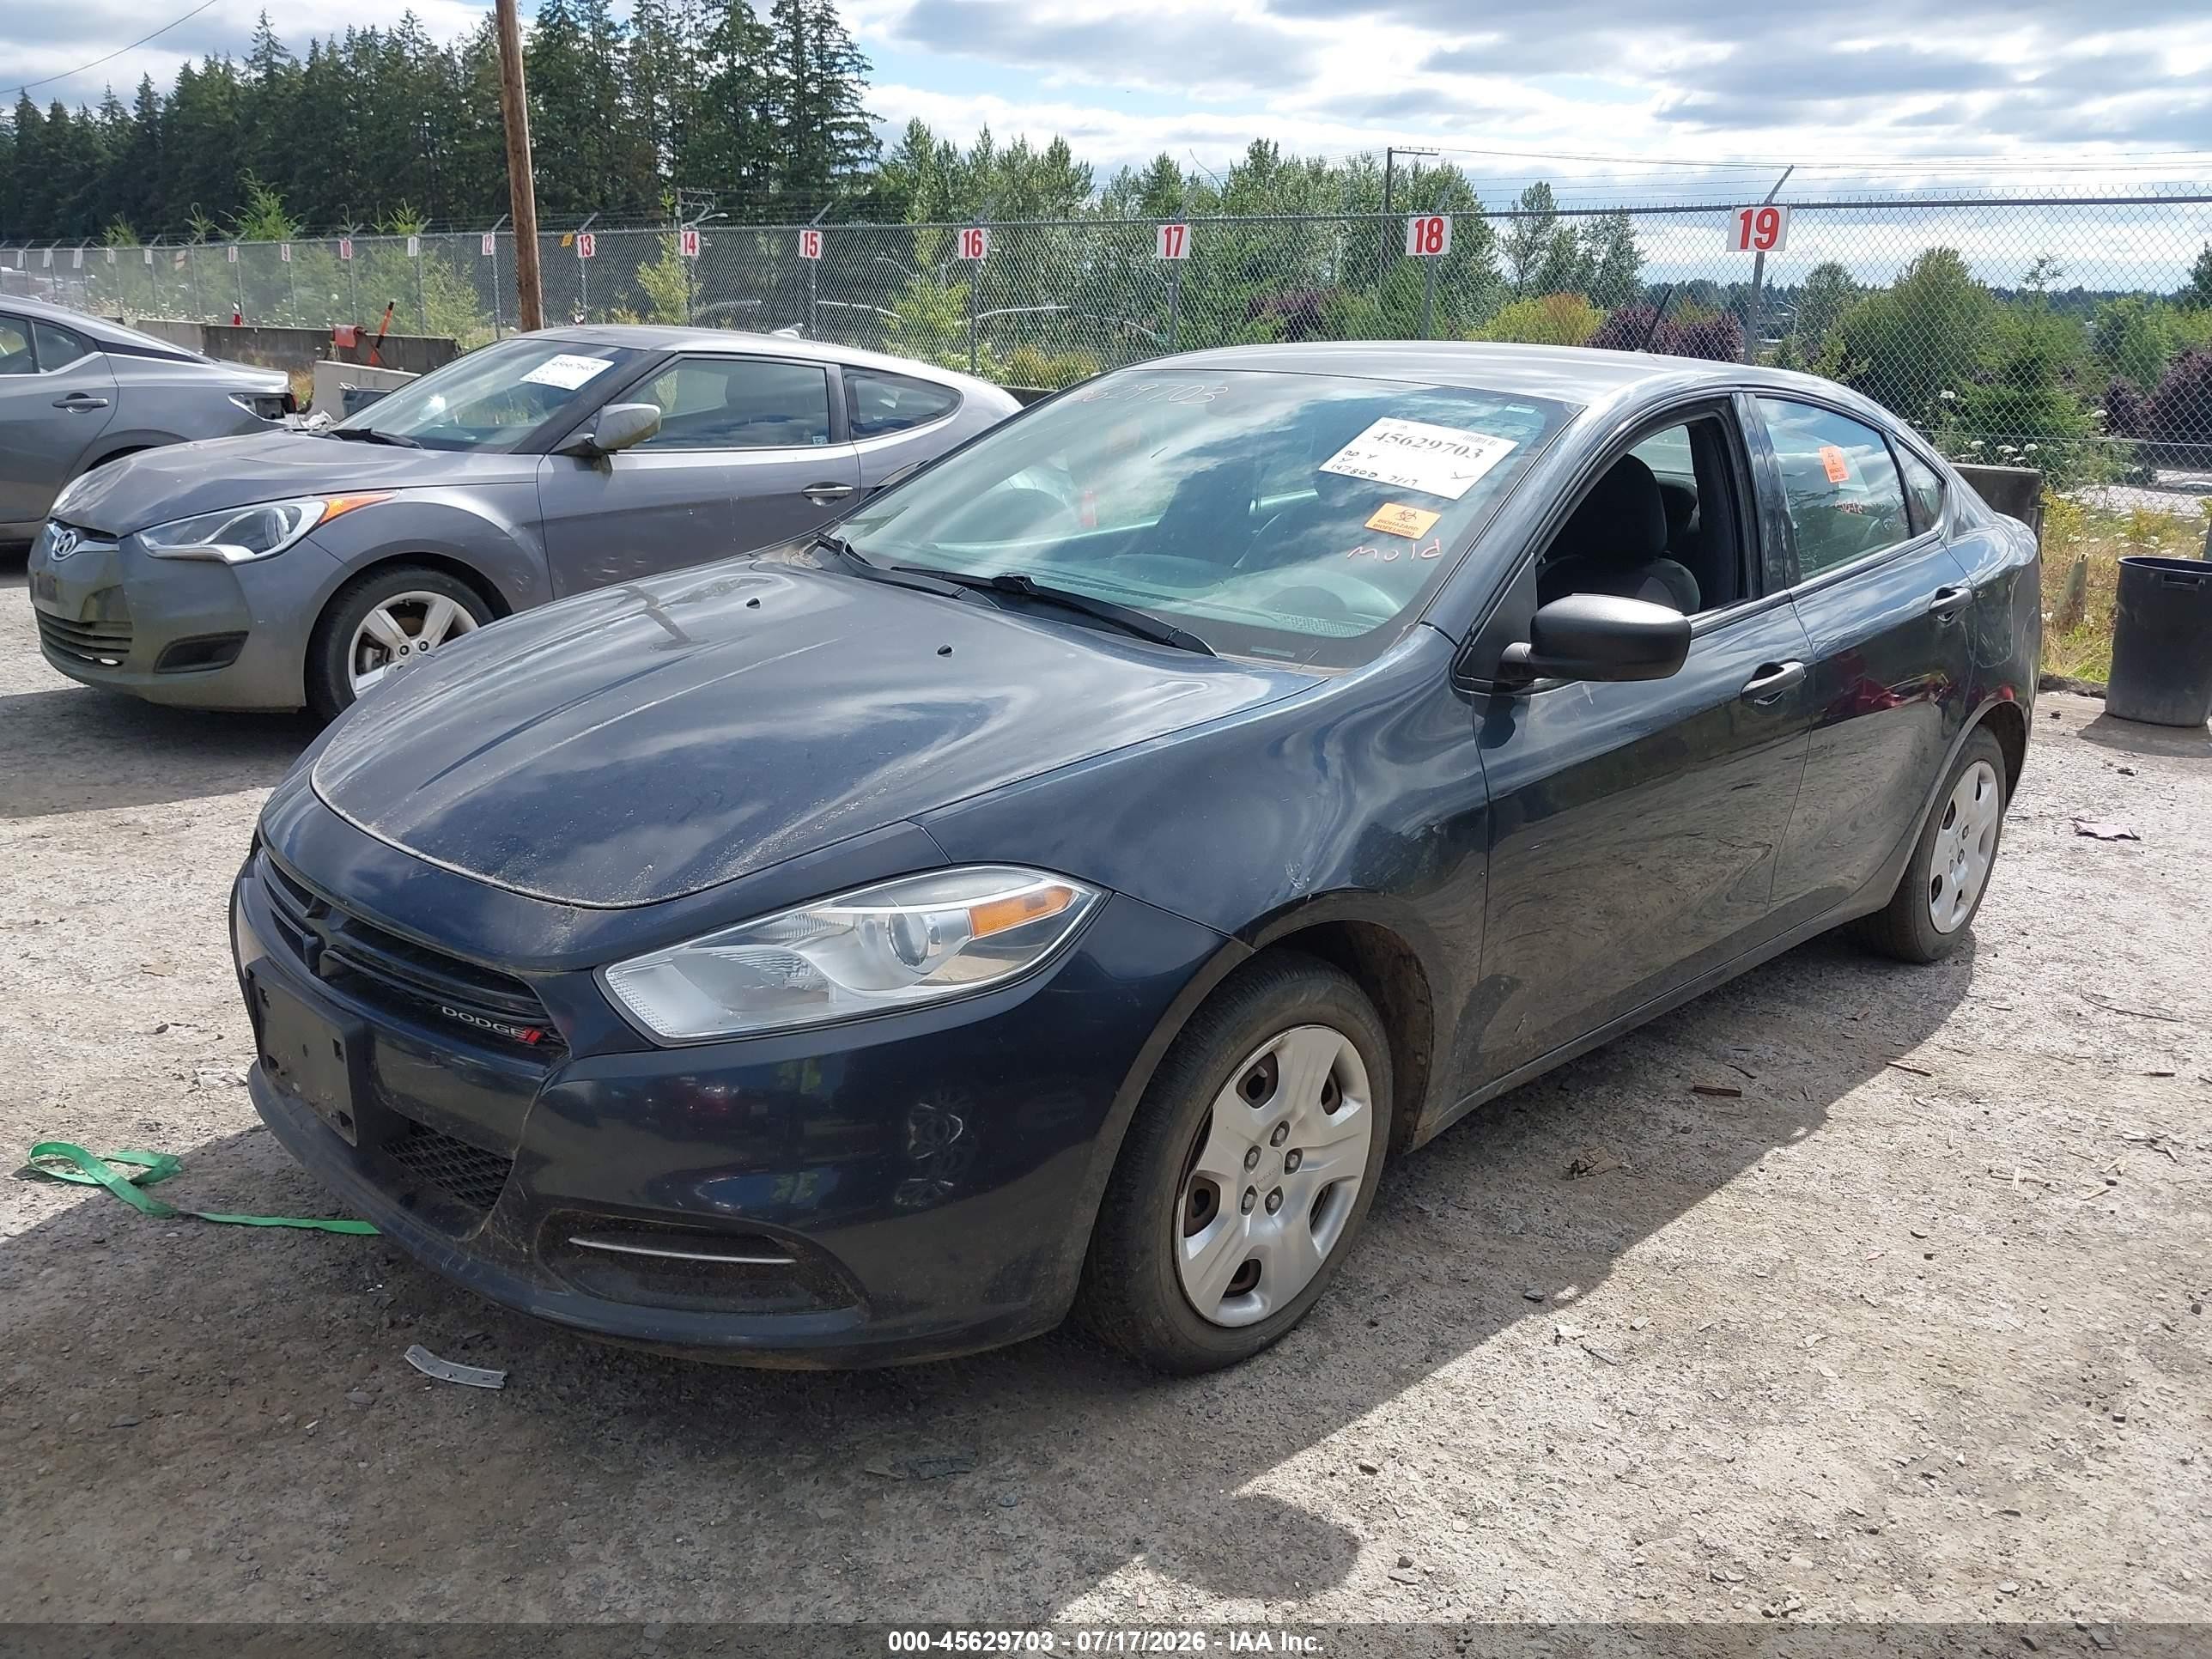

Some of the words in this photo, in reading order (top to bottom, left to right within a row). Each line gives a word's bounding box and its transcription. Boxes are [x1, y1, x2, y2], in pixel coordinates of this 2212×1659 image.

[1164, 226, 1185, 258] 17
[1414, 217, 1444, 254] 18
[1739, 207, 1780, 250] 19
[484, 234, 493, 254] 12
[580, 234, 592, 257] 13
[683, 232, 696, 255] 14
[803, 232, 818, 257] 15
[963, 229, 983, 258] 16
[1373, 431, 1485, 460] 45629703
[441, 1006, 528, 1040] DODGE
